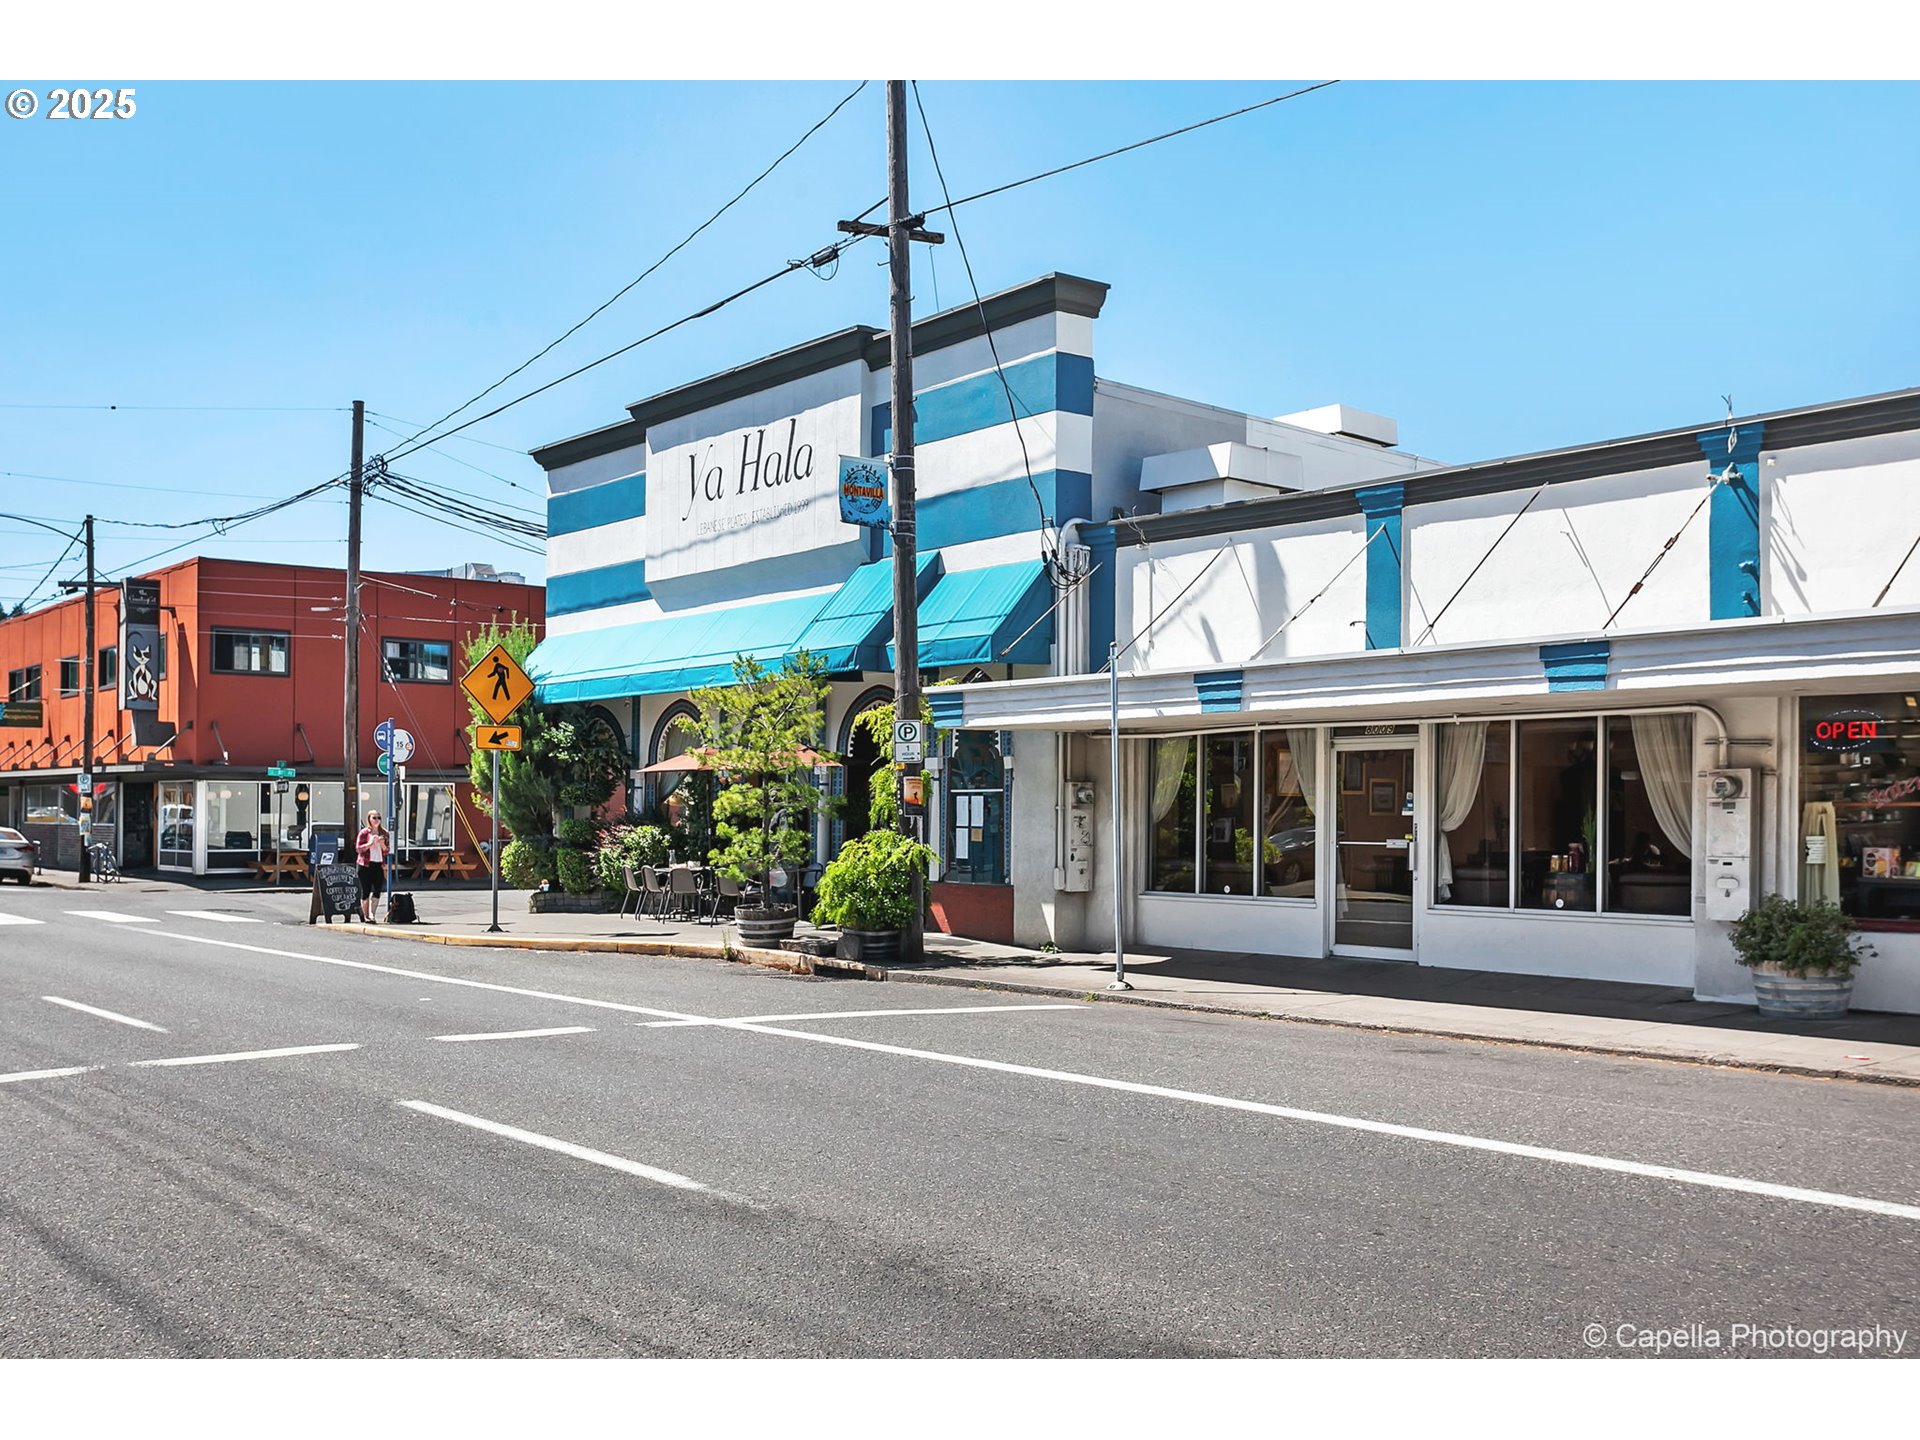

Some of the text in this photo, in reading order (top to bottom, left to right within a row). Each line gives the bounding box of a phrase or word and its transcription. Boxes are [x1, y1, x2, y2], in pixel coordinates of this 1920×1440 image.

[682, 418, 813, 521] Ya Hala
[842, 484, 885, 499] MONTAVILLA
[1815, 721, 1877, 739] OPEN
